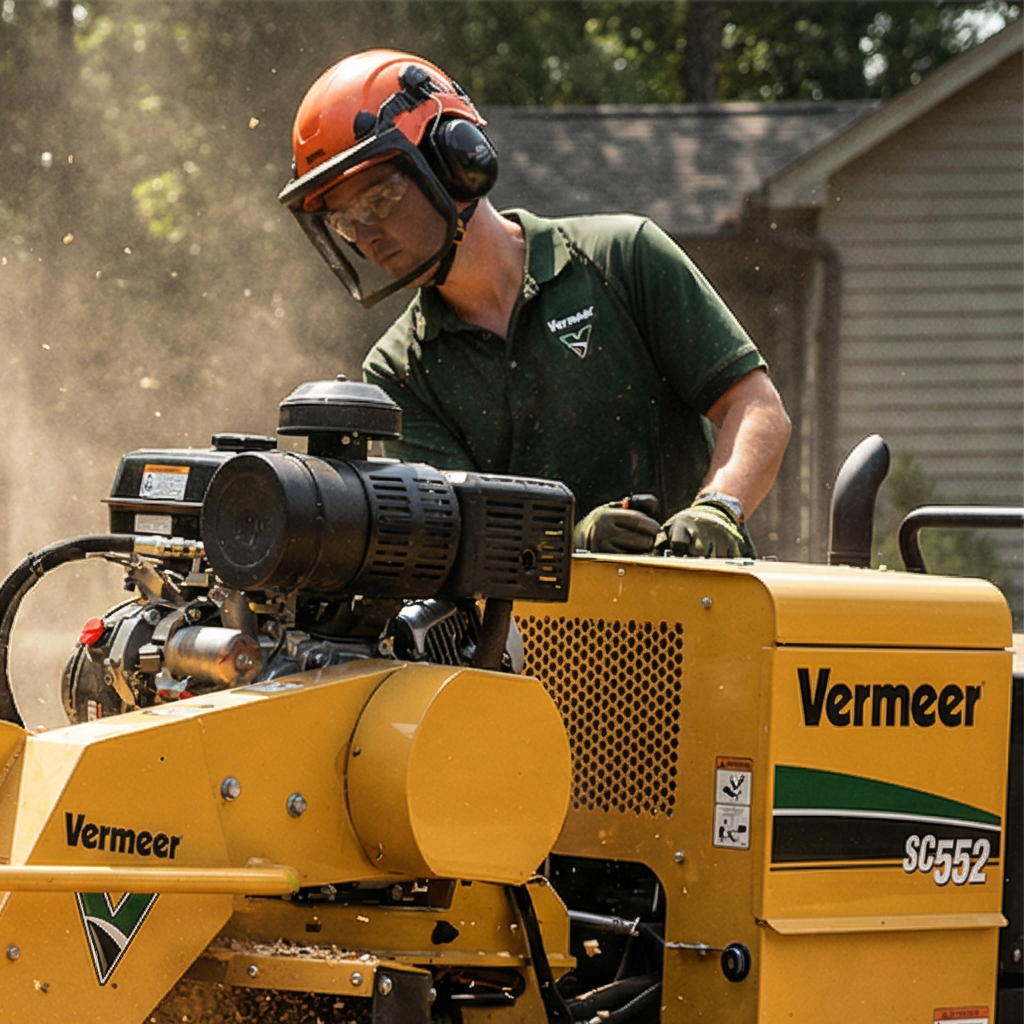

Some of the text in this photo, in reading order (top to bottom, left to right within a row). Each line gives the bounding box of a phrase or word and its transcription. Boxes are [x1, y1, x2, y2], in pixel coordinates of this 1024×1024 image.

[797, 667, 982, 728] Vermeer
[65, 811, 181, 860] Vermeer
[902, 834, 991, 886] SC552
